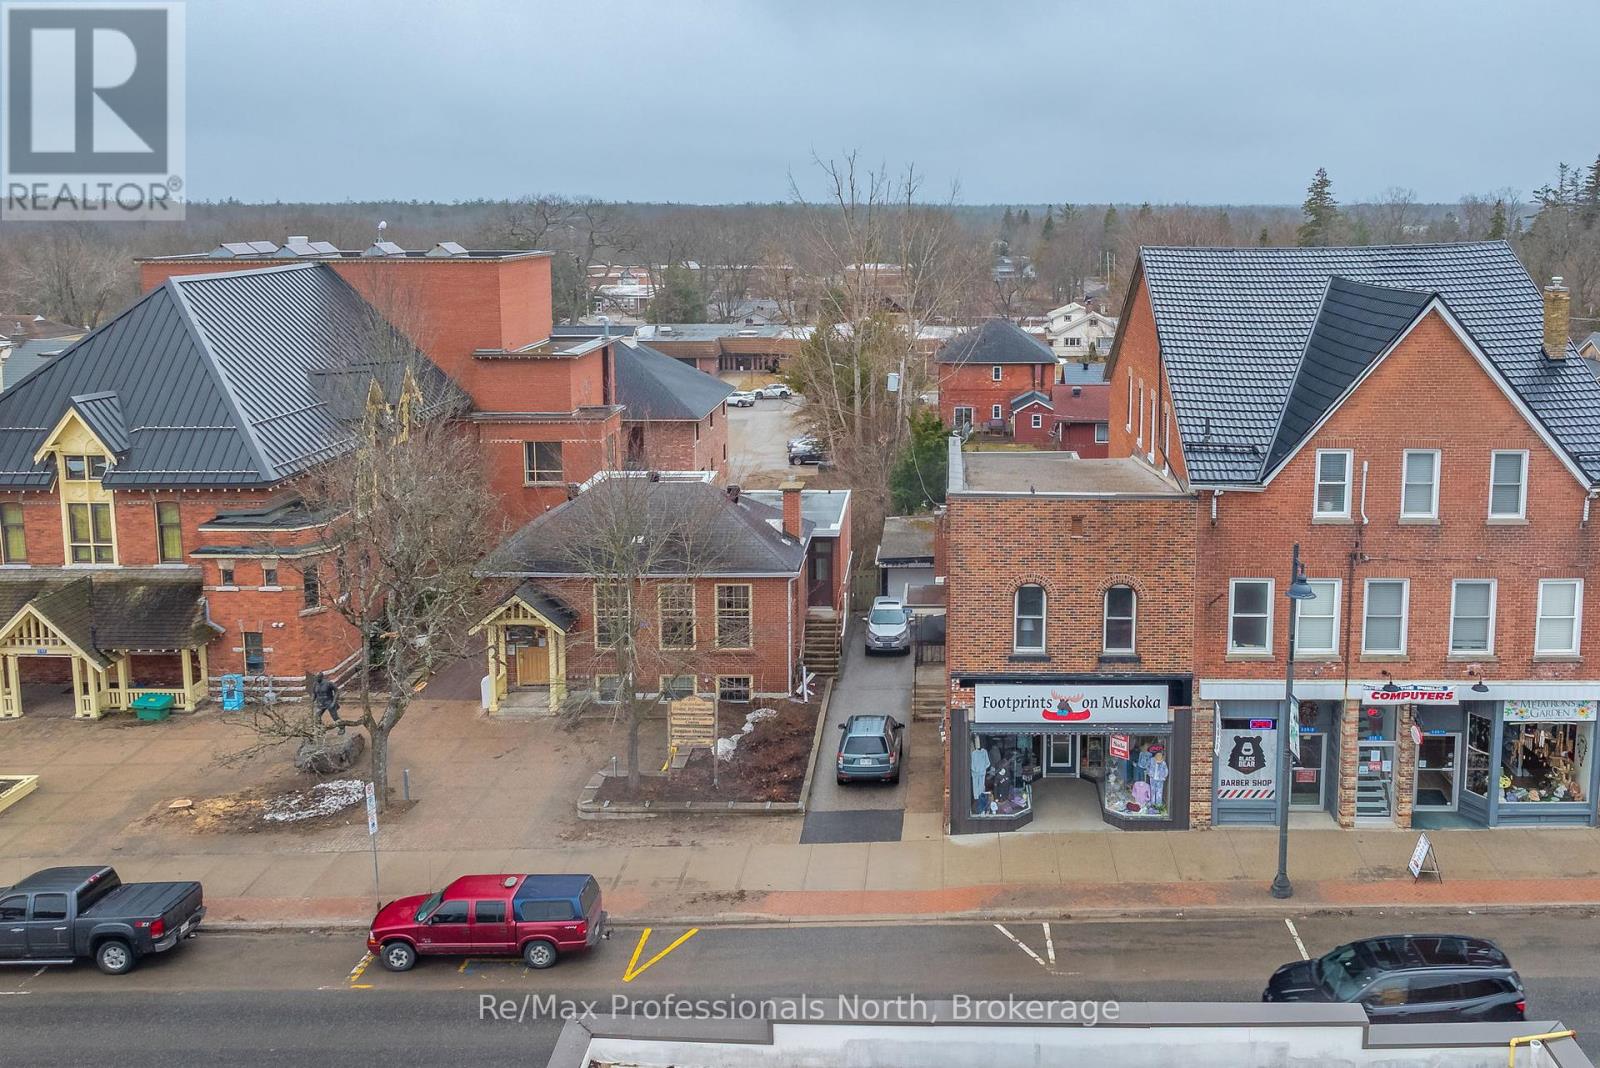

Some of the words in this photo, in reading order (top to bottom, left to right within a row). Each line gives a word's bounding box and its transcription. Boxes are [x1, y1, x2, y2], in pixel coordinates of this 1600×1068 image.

[1371, 691, 1454, 701] COMPUTERS
[983, 696, 1053, 713] Footprints
[1082, 699, 1099, 709] on
[1102, 696, 1162, 709] Muskoka
[1529, 708, 1571, 718] GARDEN
[1220, 779, 1250, 787] BARBER
[1252, 779, 1272, 787] SHOP
